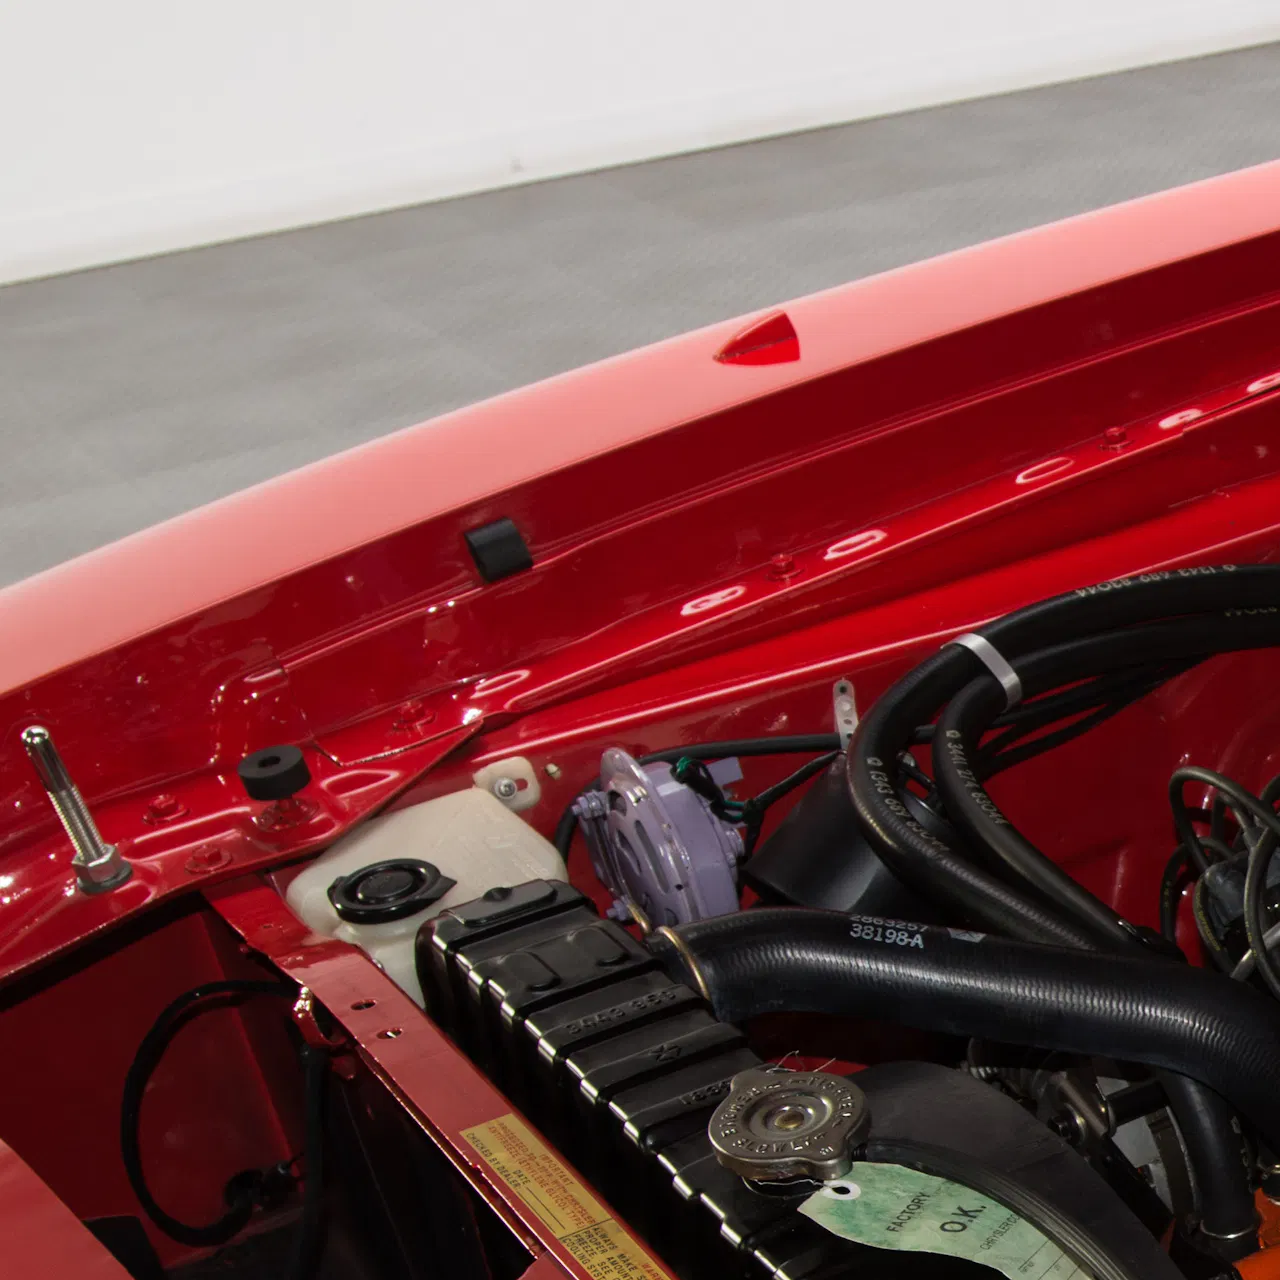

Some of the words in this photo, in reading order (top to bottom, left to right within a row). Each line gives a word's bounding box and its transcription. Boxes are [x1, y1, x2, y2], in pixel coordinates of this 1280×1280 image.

[849, 923, 925, 950] 38198-A
[465, 1132, 493, 1157] CHECKED
[488, 1157, 500, 1165] BY
[512, 1169, 531, 1184] DATE
[538, 1153, 574, 1186] IMPORTANT
[544, 1187, 569, 1209] GLYCOL
[563, 1194, 597, 1225] CHRYSLER
[885, 1191, 931, 1233] FACTORY
[939, 1203, 987, 1234] O.K.
[561, 1237, 590, 1264] COOLING
[581, 1230, 608, 1254] PROPER
[590, 1226, 618, 1250] ALWAYS
[615, 1253, 637, 1271] MAKE
[978, 1221, 1013, 1251] CHRYSLER
[596, 1261, 615, 1276] SEE
